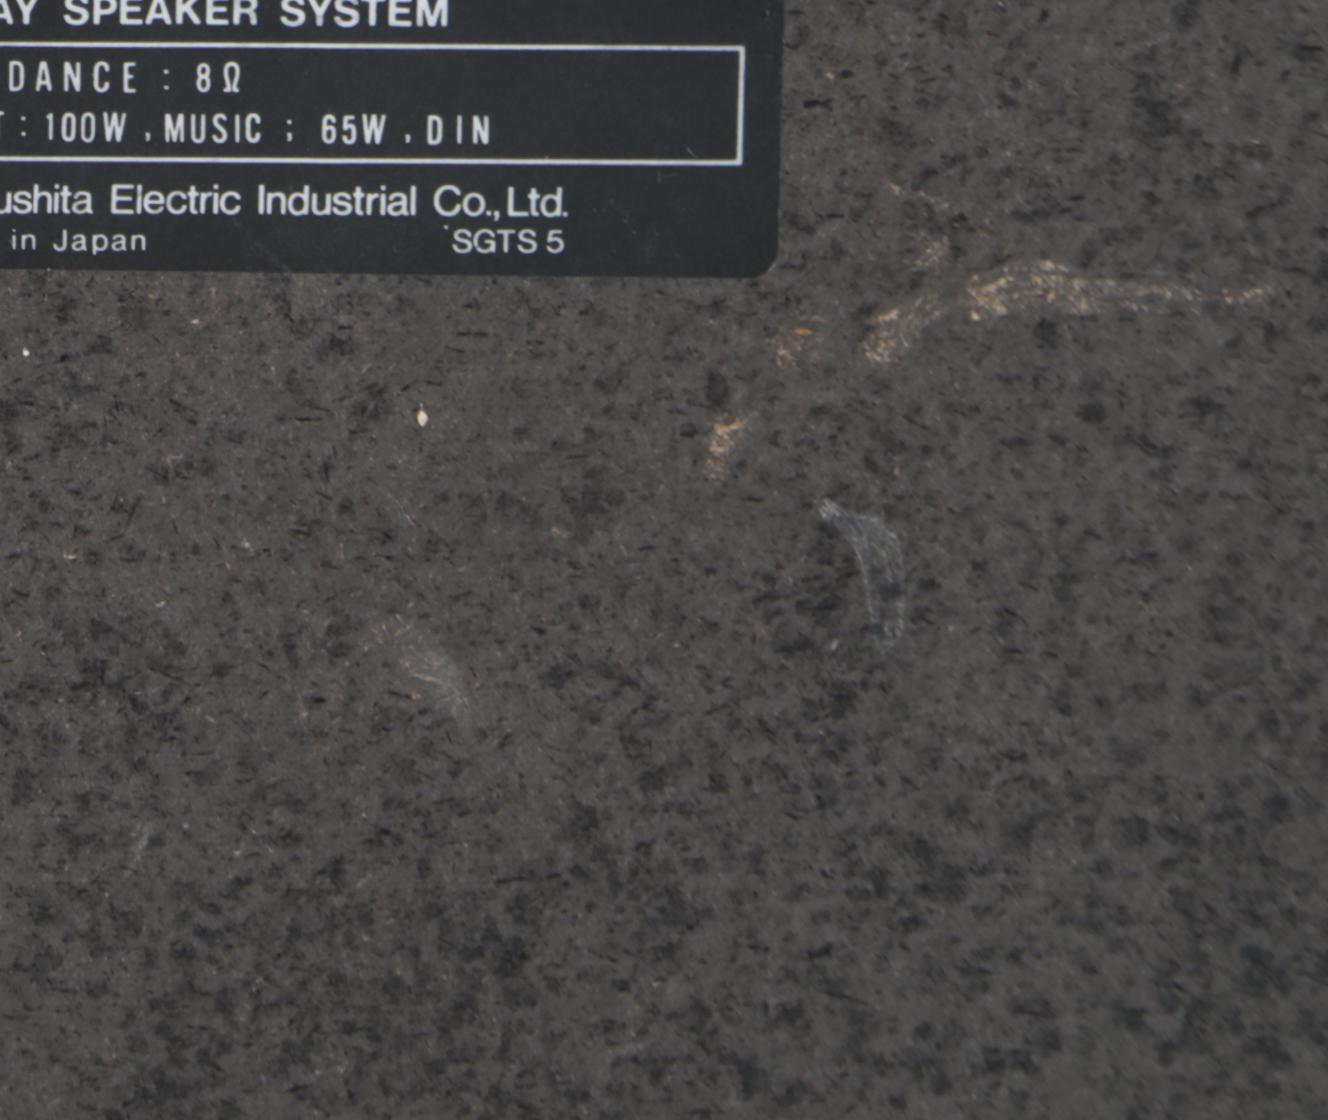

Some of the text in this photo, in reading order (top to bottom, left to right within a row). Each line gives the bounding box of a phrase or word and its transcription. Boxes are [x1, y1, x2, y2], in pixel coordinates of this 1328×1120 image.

[109, 182, 243, 217] Electric
[256, 182, 418, 218] Industrial
[10, 227, 38, 252] in
[51, 228, 148, 256] Japan
